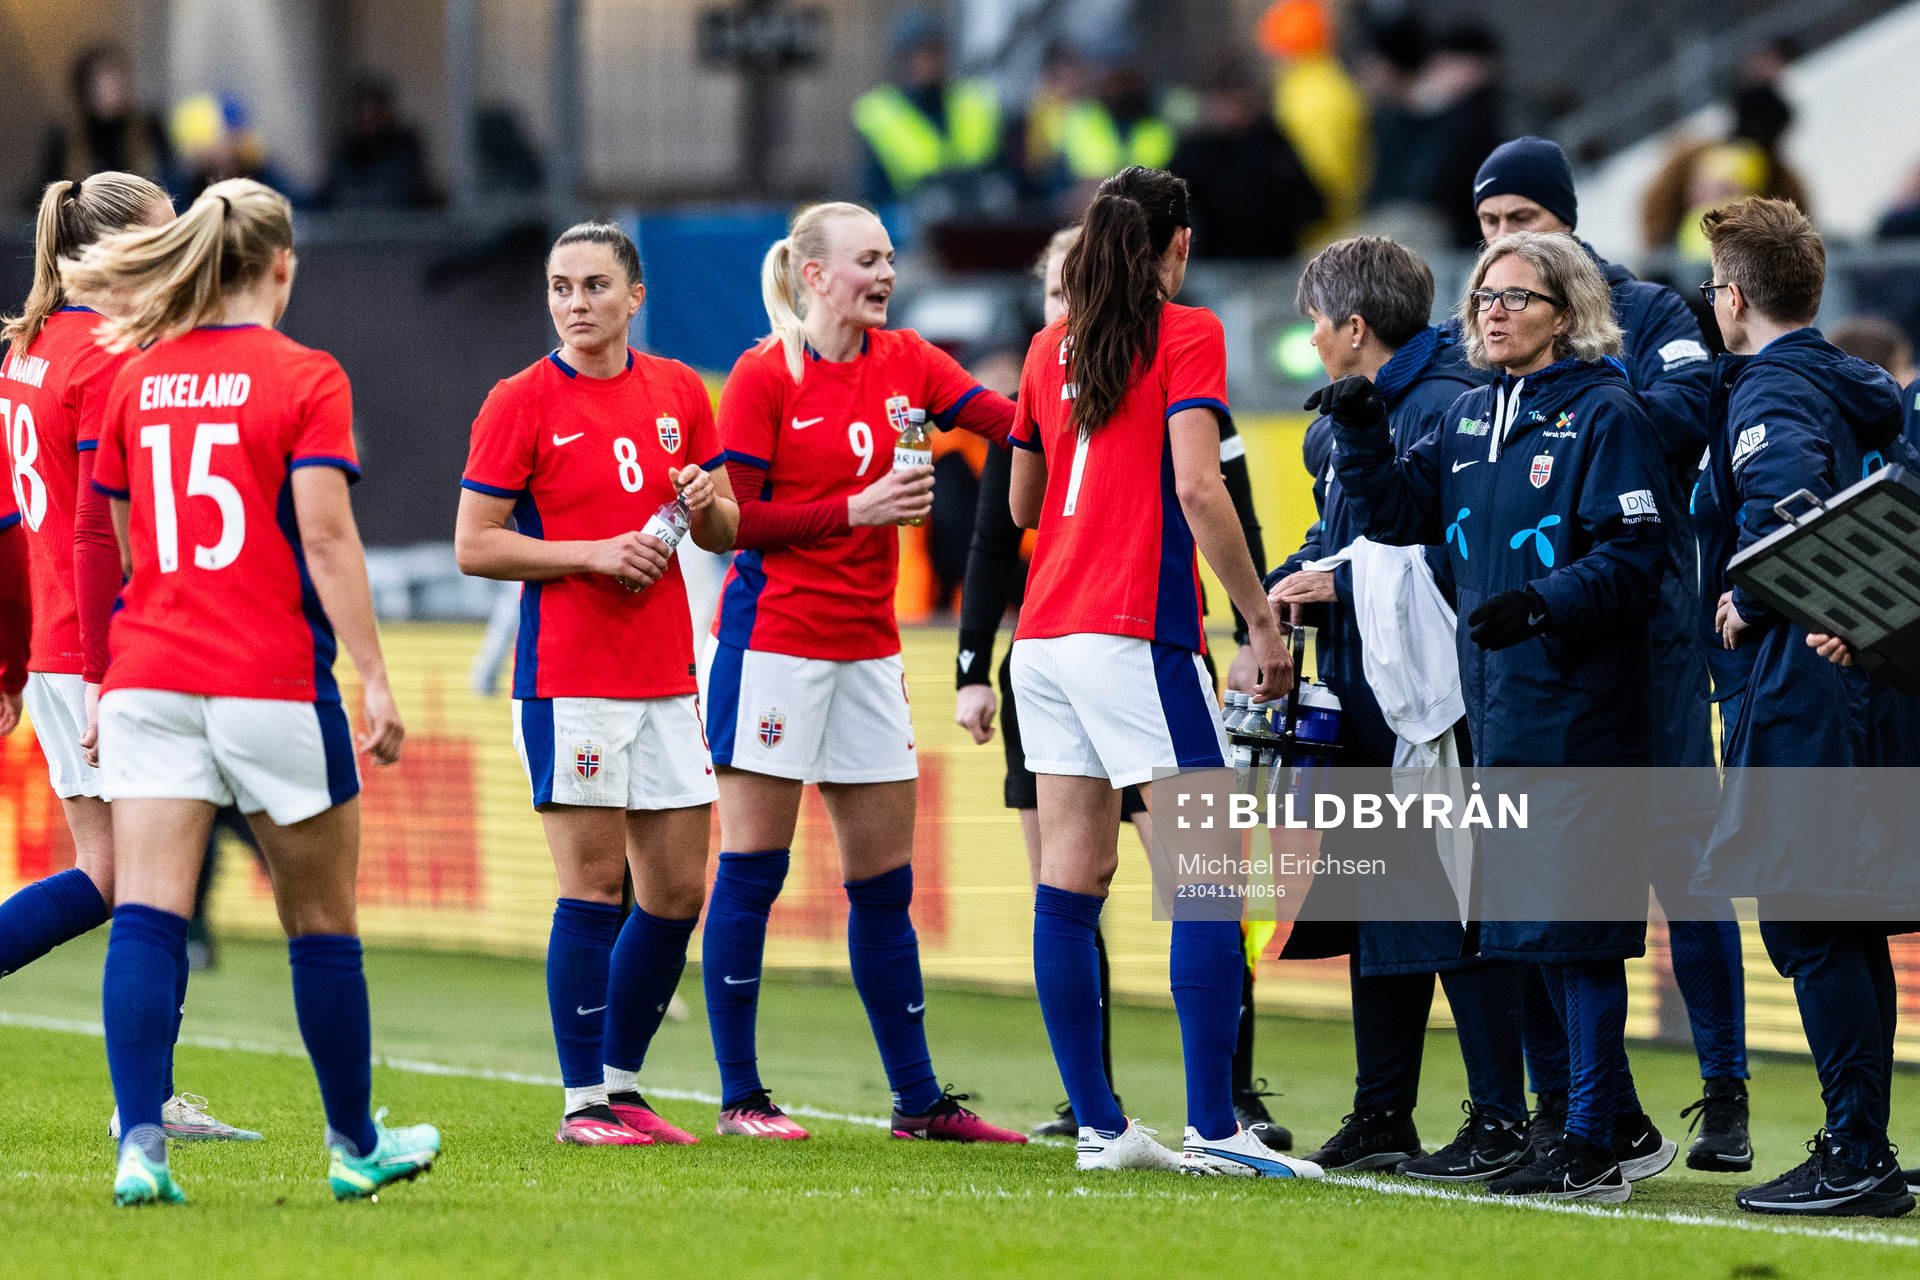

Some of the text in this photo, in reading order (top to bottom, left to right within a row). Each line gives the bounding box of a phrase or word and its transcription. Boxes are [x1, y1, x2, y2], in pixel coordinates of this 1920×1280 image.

[140, 373, 251, 411] EIKELAND
[612, 436, 645, 493] 8
[847, 421, 875, 477] 9
[140, 423, 246, 574] 15
